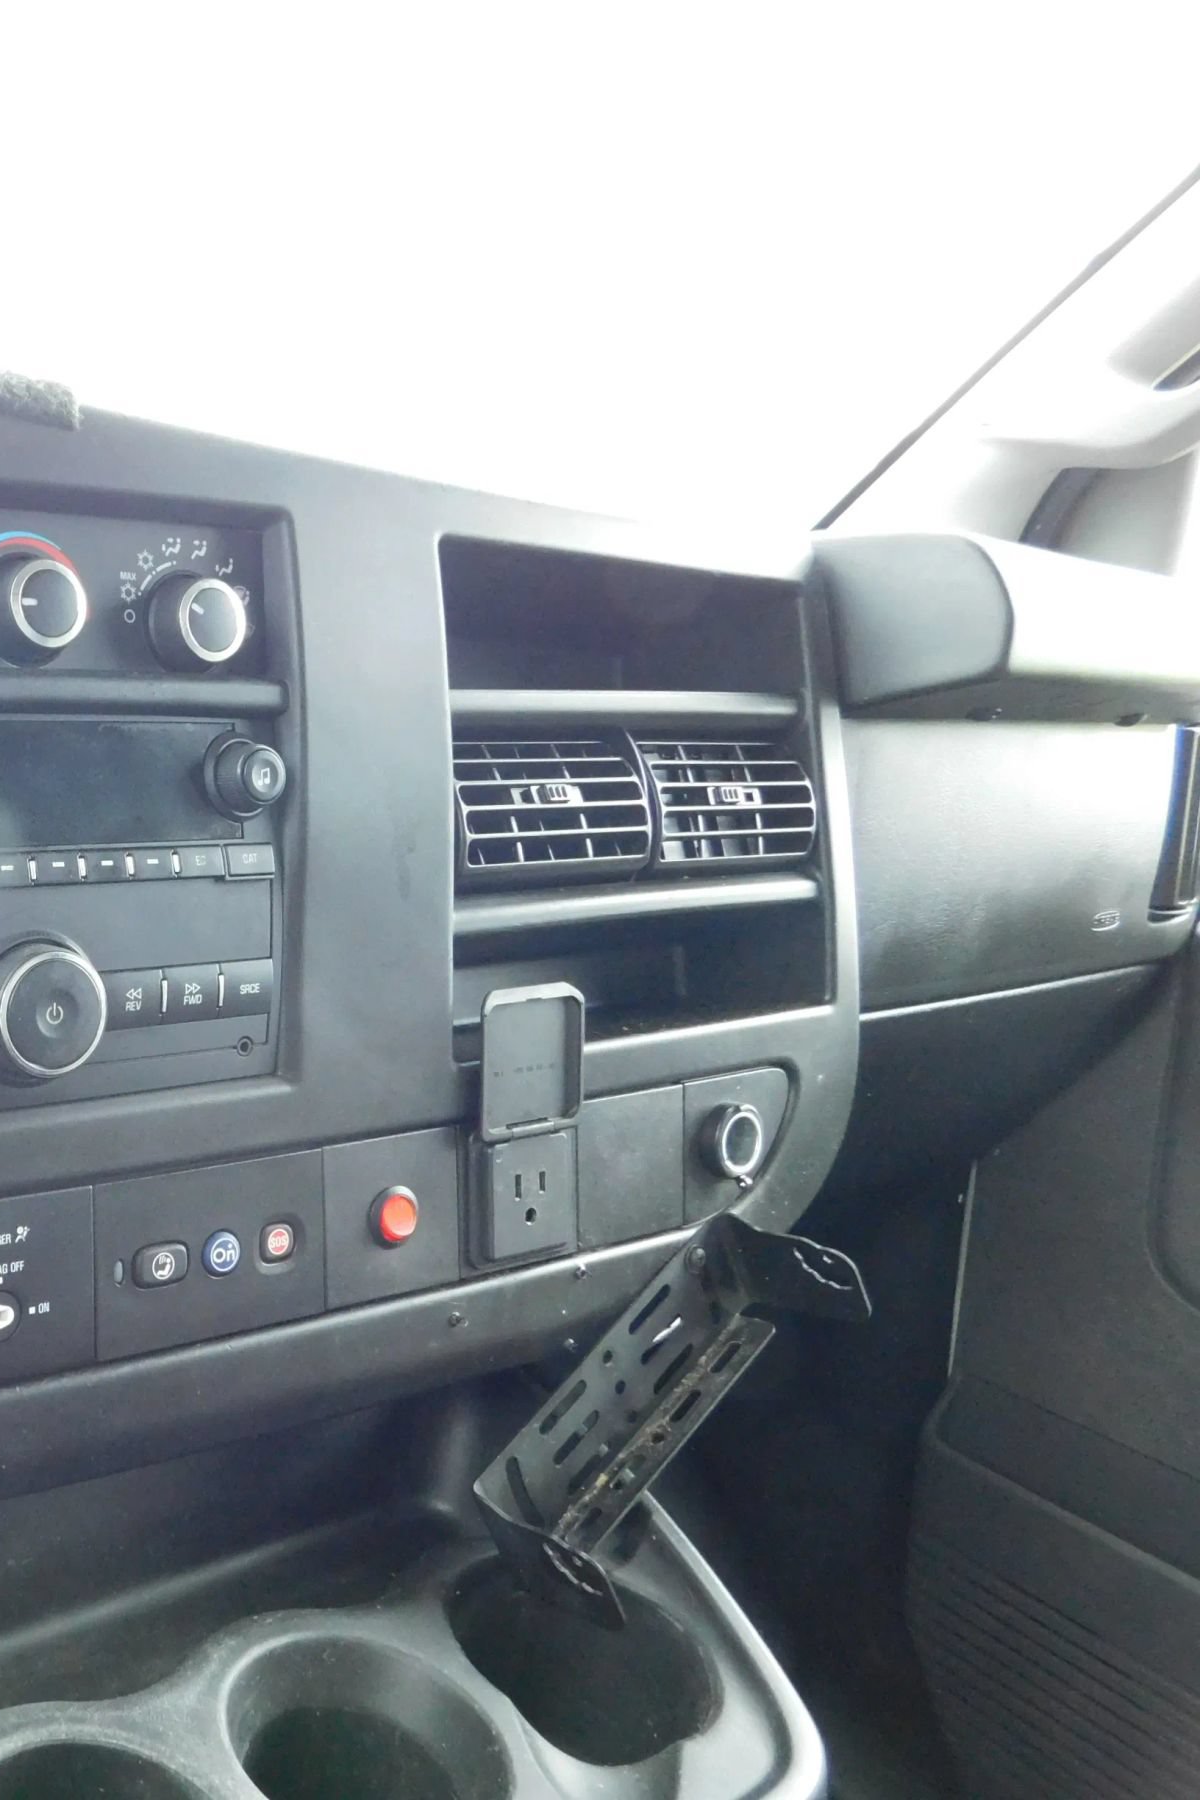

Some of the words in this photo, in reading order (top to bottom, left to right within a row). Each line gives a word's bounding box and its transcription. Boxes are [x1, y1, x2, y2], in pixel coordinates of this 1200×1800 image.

[120, 571, 137, 581] MAX
[242, 853, 257, 864] CAT
[239, 983, 261, 995] SRCE
[125, 1000, 142, 1012] REV
[183, 994, 203, 1006] FWD
[269, 1234, 289, 1249] SOS
[10, 1260, 25, 1273] OFF
[38, 1302, 50, 1314] ON
